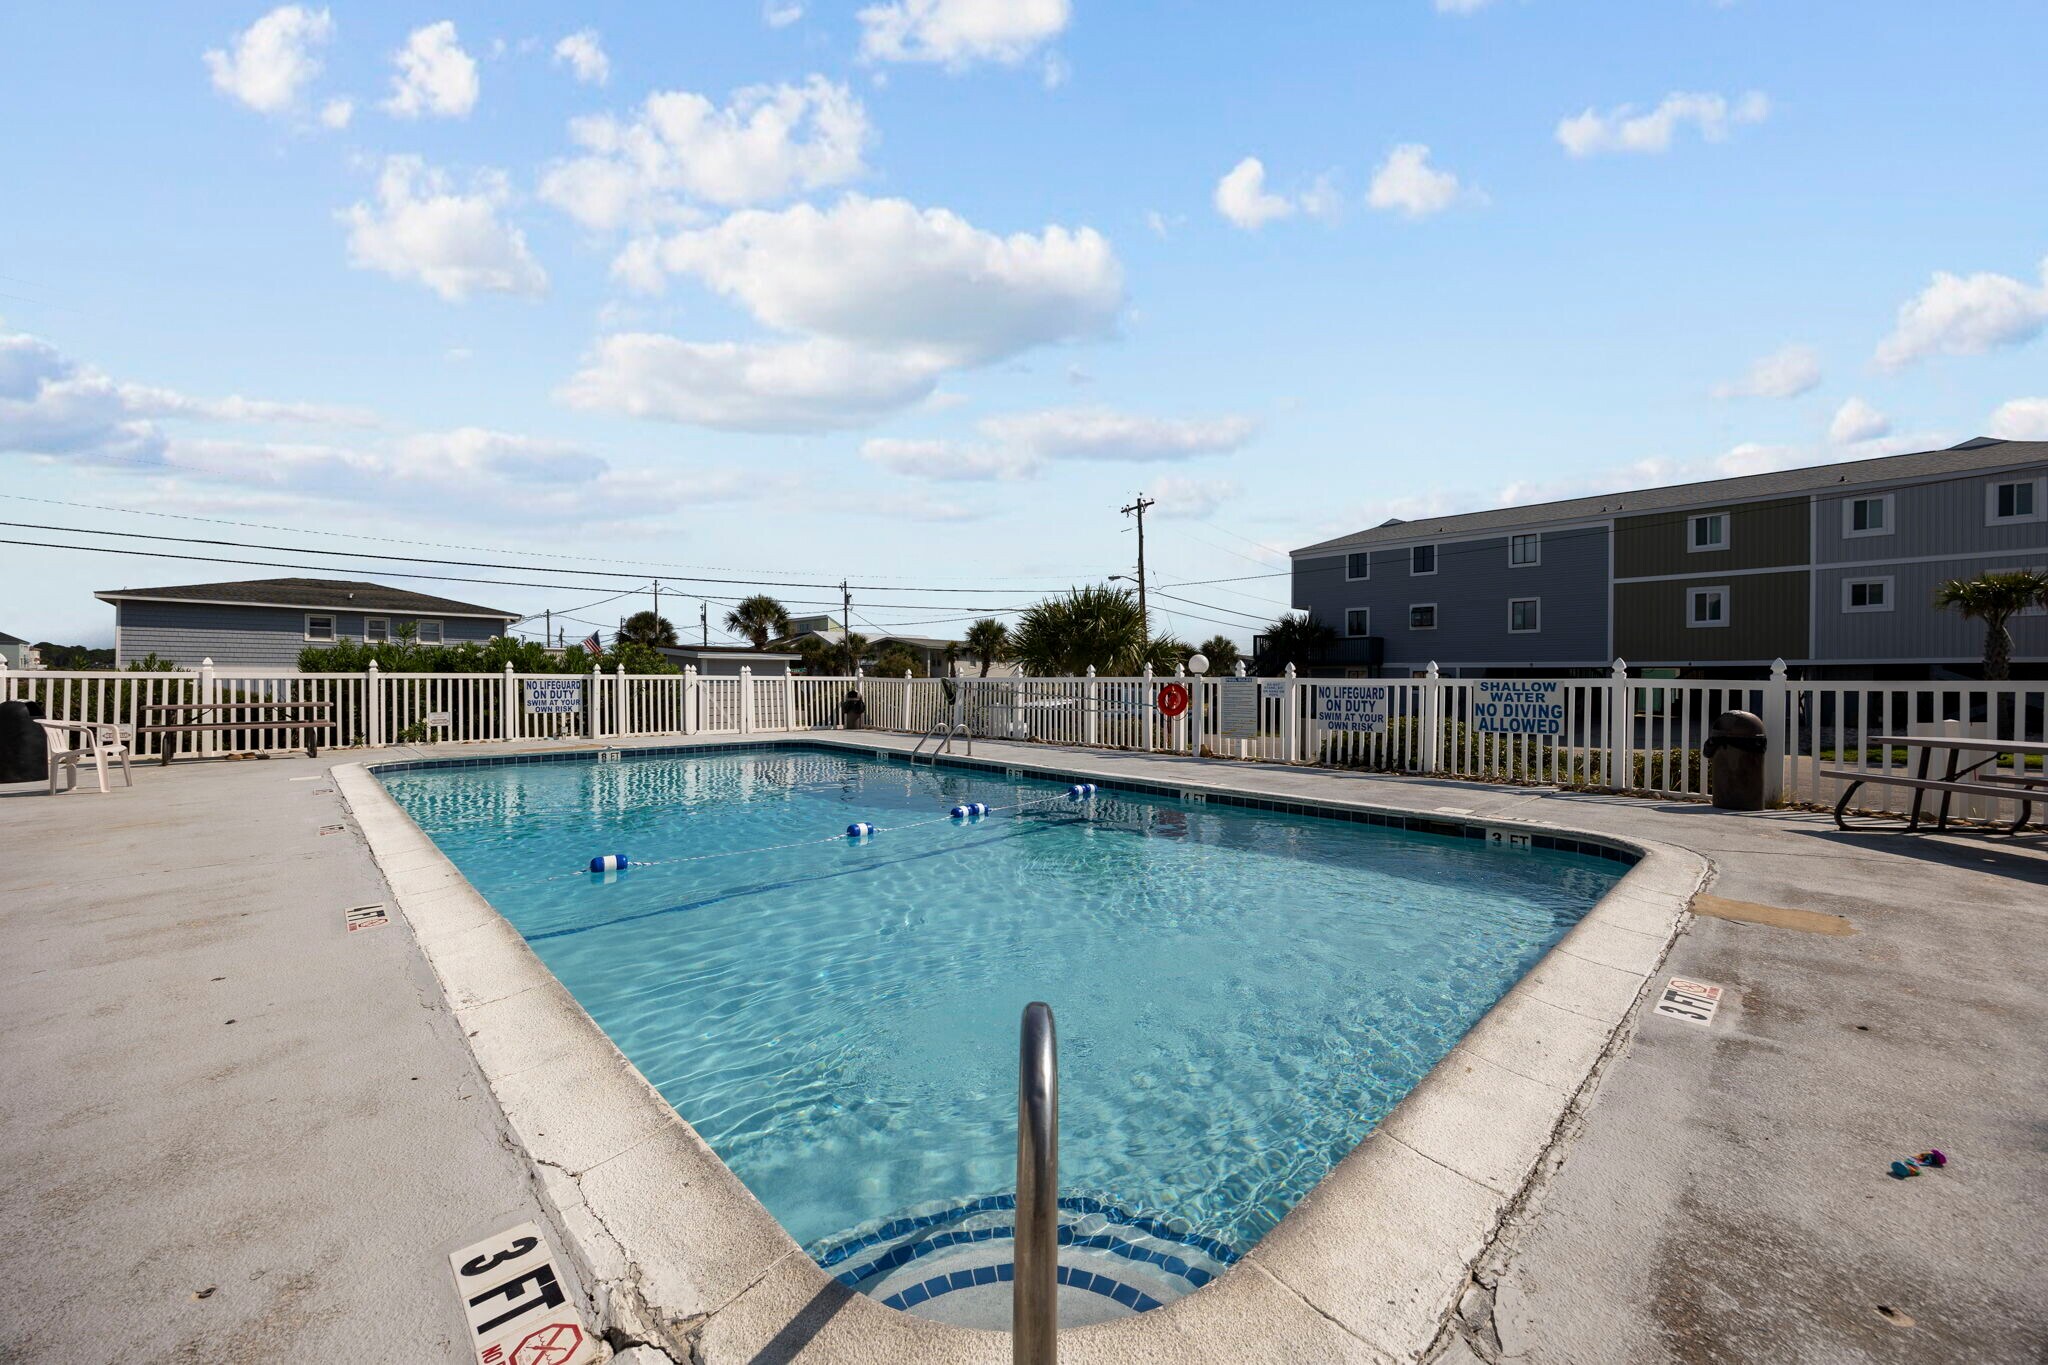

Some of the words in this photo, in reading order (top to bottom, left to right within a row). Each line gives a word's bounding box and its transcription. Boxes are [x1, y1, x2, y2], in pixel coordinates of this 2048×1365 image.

[526, 681, 537, 690] NO
[540, 681, 580, 690] LIFEGUARD
[1480, 681, 1557, 692] SHALLOW
[533, 690, 547, 699] ON
[550, 690, 574, 699] DUTY
[1318, 686, 1331, 699] NO
[1334, 687, 1385, 700] LIFEGUARD
[1490, 692, 1546, 703] WATER
[1326, 700, 1341, 711] ON
[1345, 700, 1376, 713] DUTY
[1475, 702, 1497, 717] NO
[1503, 704, 1563, 719] DIVING
[1319, 711, 1342, 721] SWIM
[1344, 713, 1355, 722] AT
[1359, 713, 1384, 723] YOUR
[1328, 721, 1348, 730] OWN
[1352, 722, 1374, 731] RISK
[1478, 717, 1560, 734] ALLOWED
[460, 1236, 538, 1277] 3
[469, 1263, 566, 1336] FT
[481, 1343, 503, 1364] NO
